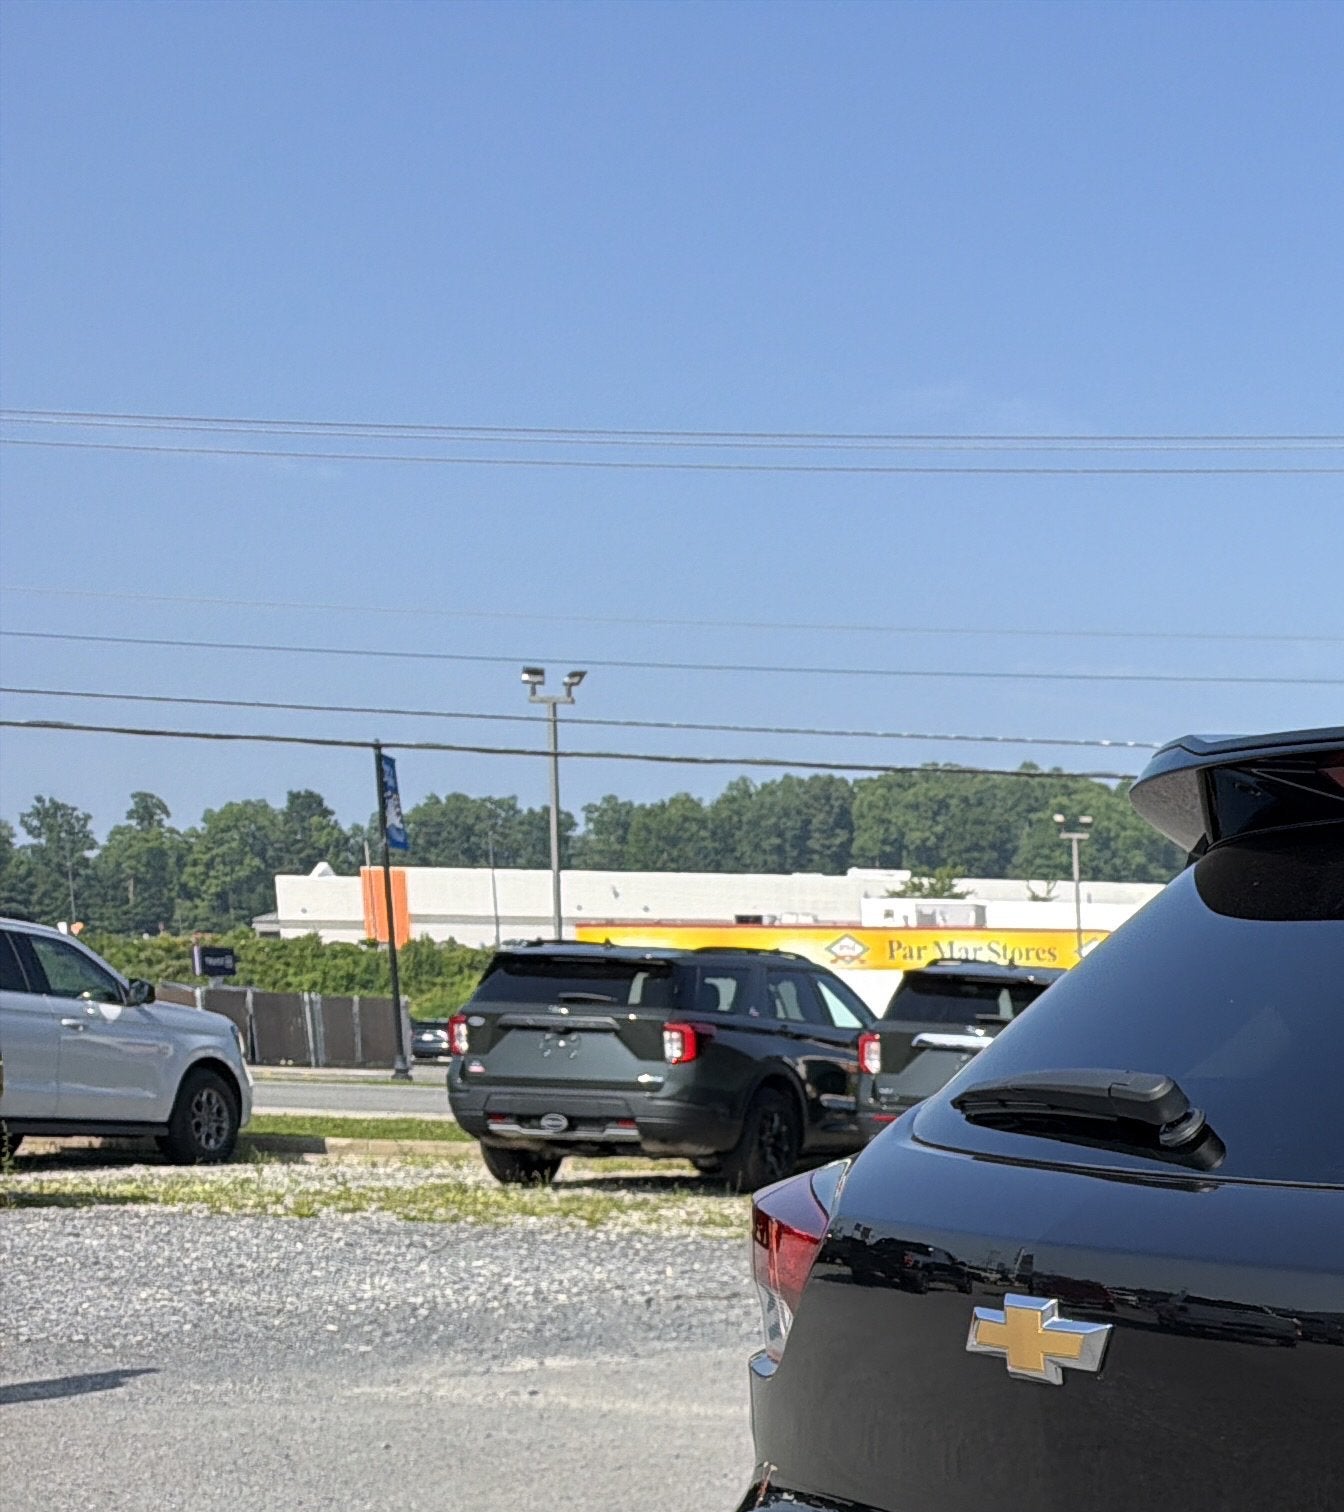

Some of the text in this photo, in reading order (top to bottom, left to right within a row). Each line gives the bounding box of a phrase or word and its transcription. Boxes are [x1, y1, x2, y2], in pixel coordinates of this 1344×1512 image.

[888, 939, 1057, 962] Par Mar Stores
